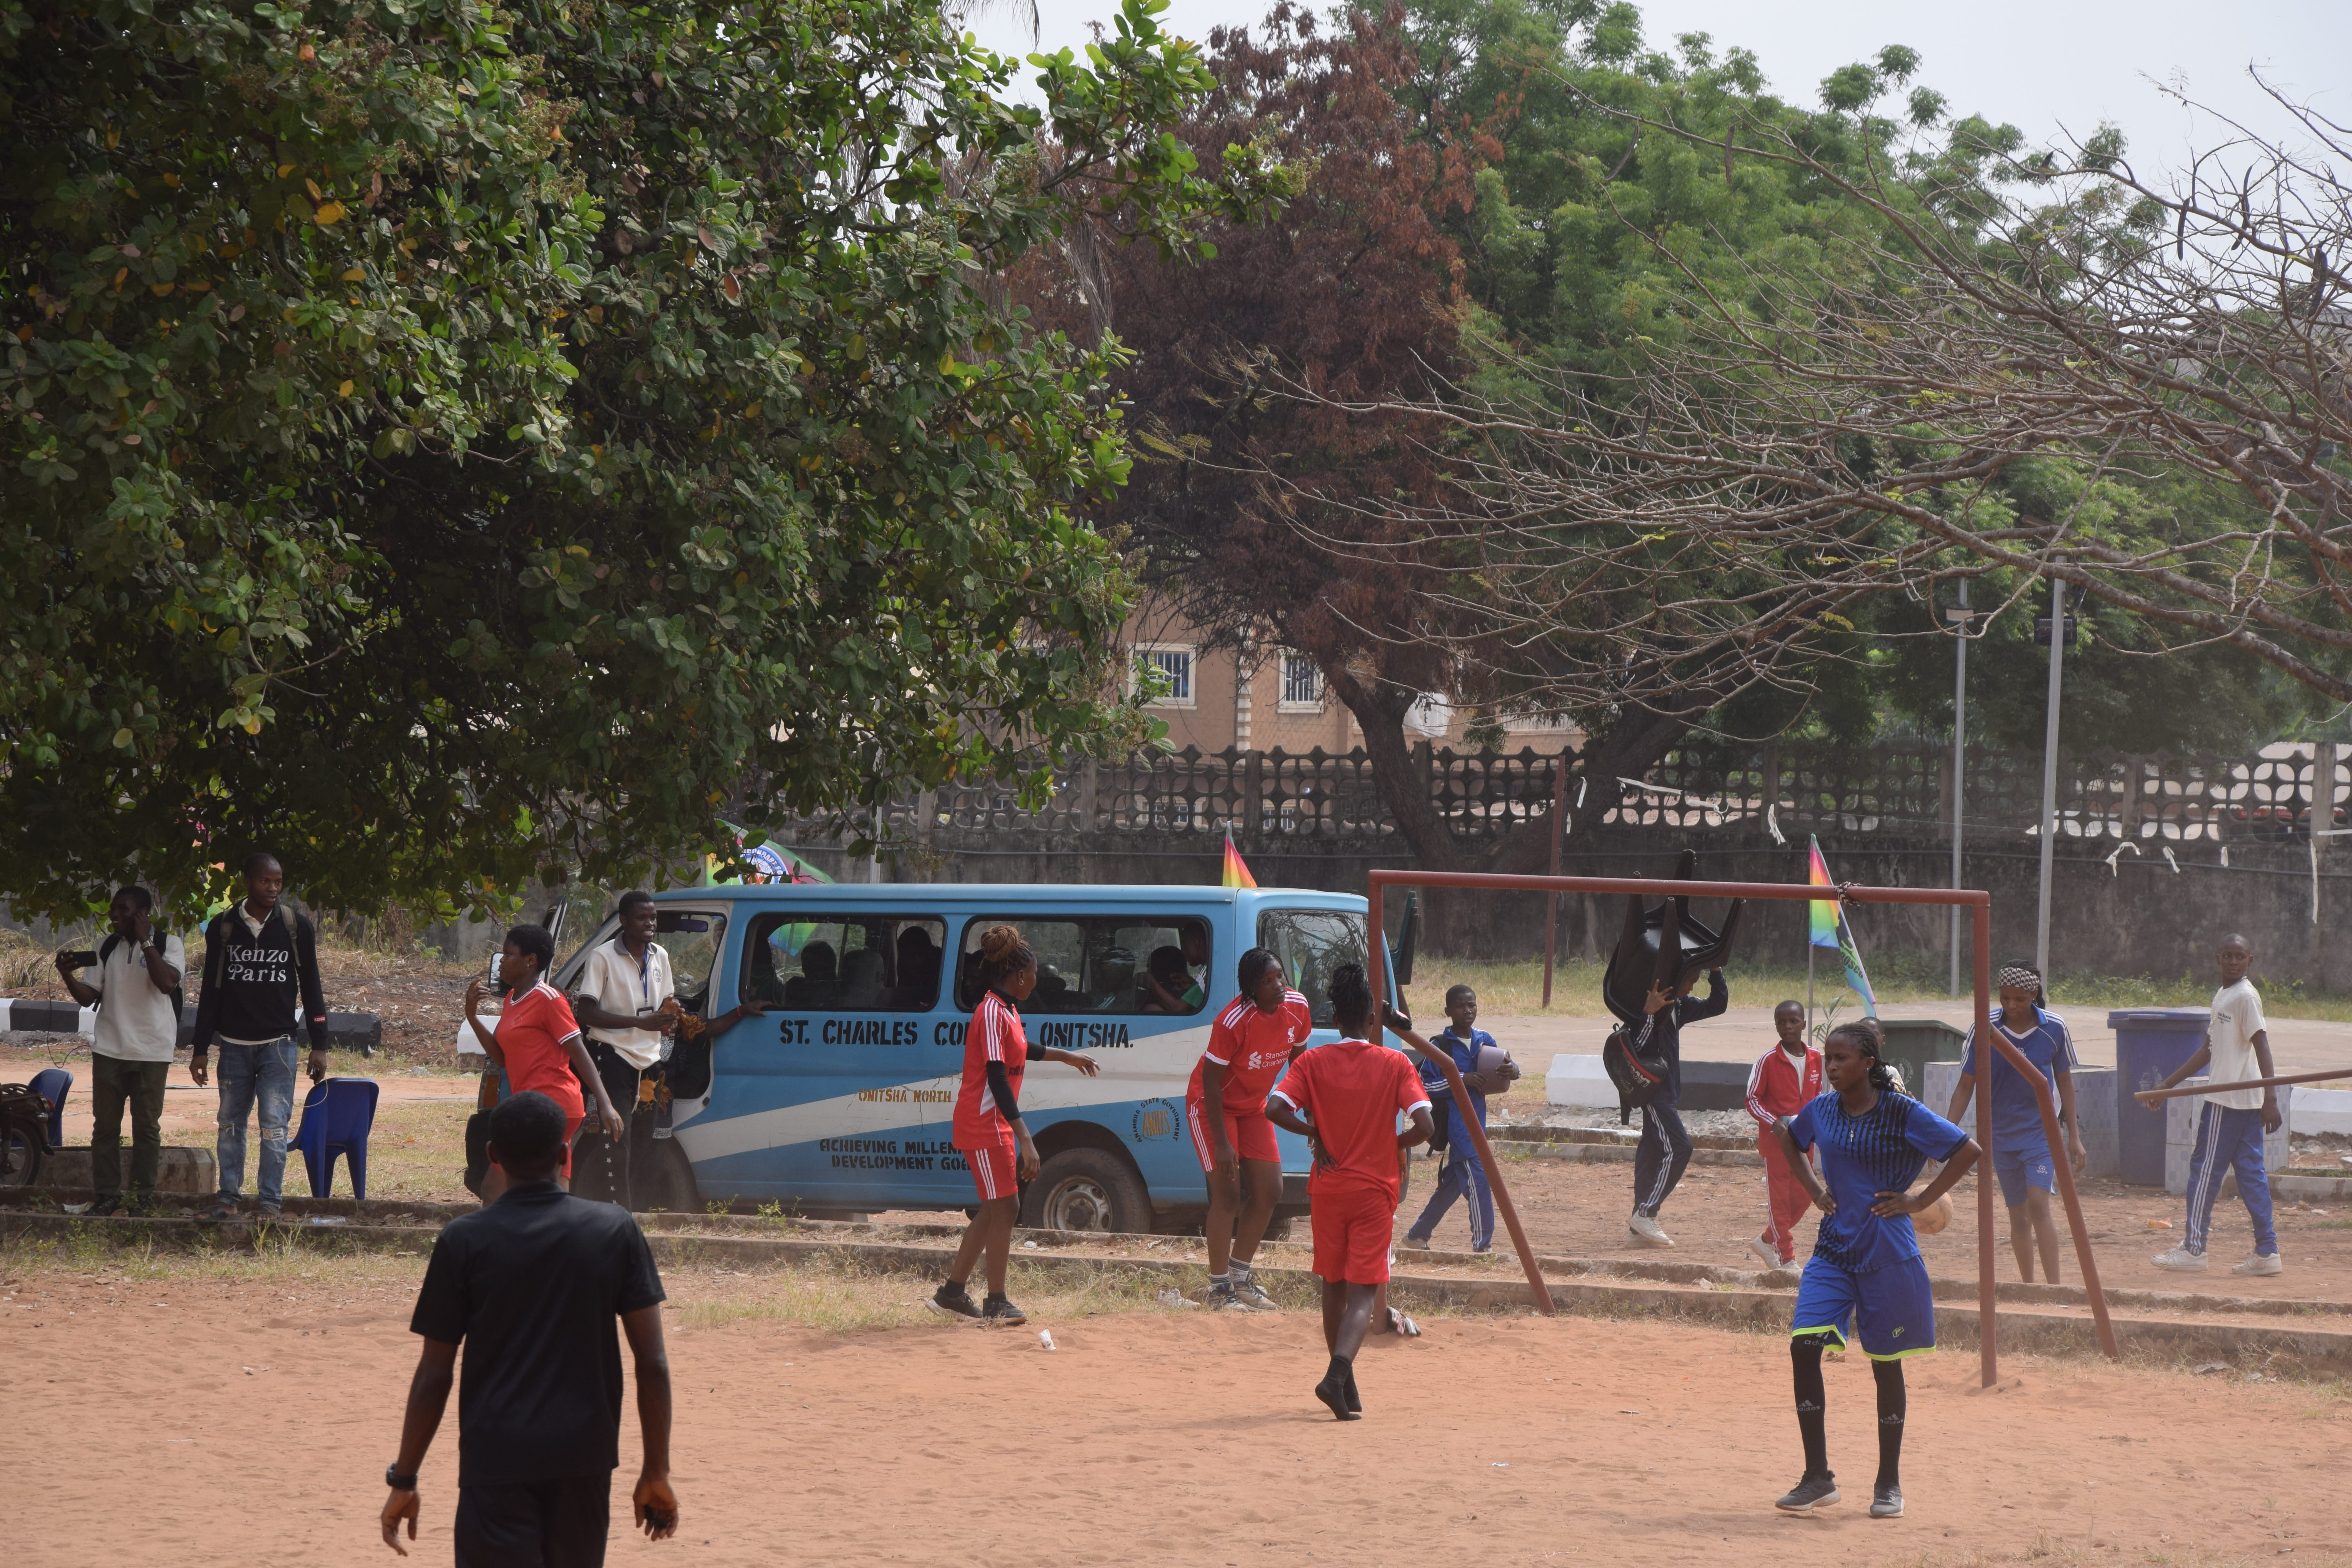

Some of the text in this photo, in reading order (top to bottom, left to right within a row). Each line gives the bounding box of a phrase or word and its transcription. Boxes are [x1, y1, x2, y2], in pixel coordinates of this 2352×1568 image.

[227, 945, 289, 962] Kenzo
[228, 964, 287, 982] Paris
[780, 1020, 810, 1044] ST.
[823, 1020, 918, 1045] CHARLES
[1040, 1022, 1134, 1048] ONITSHA.
[1262, 1056, 1289, 1068] Chartere
[1265, 1047, 1292, 1060] Standard
[858, 1089, 951, 1103] ONITSHA NORTH
[1141, 1097, 1160, 1108] STATE
[1161, 1099, 1180, 1142] GOVERNMENT
[819, 1138, 962, 1154] ACHIEVING MILLEN
[831, 1154, 971, 1171] DEVELOPMENT GOA
